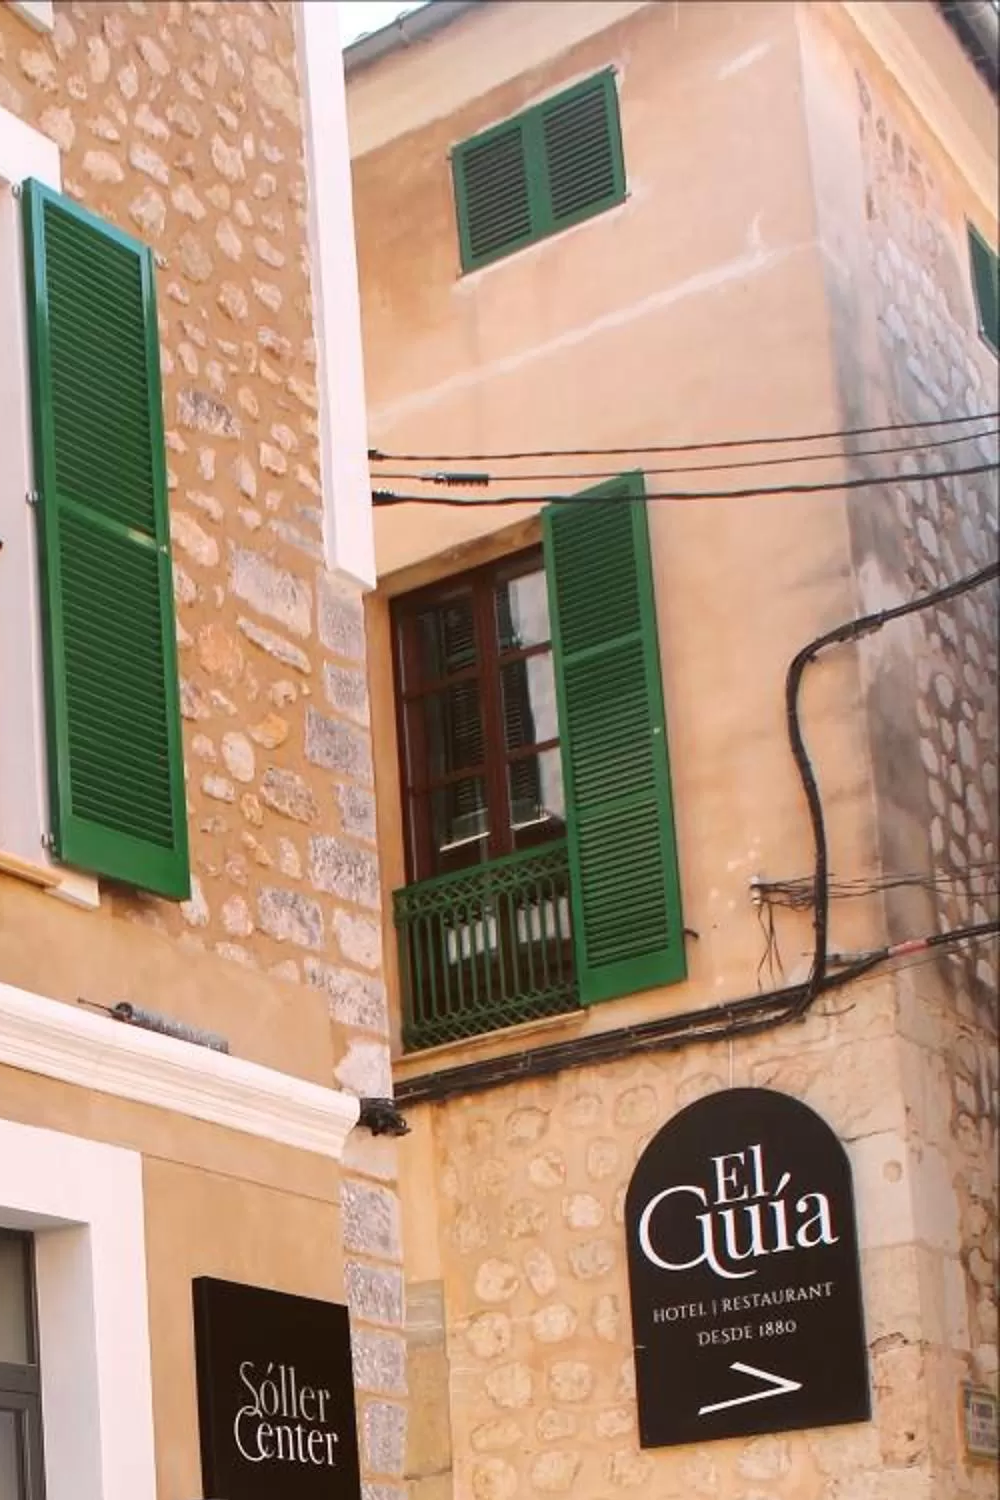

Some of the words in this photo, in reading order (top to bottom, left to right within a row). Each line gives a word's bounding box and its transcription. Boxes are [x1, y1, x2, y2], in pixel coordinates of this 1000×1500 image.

[711, 1143, 770, 1206] El
[638, 1172, 840, 1280] Guía
[652, 1302, 707, 1324] HOTEL
[720, 1281, 835, 1312] RESTAURANT
[696, 1322, 754, 1347] DESDE
[758, 1318, 798, 1339] 1880
[238, 1360, 332, 1423] Sóller
[233, 1405, 339, 1466] Center
